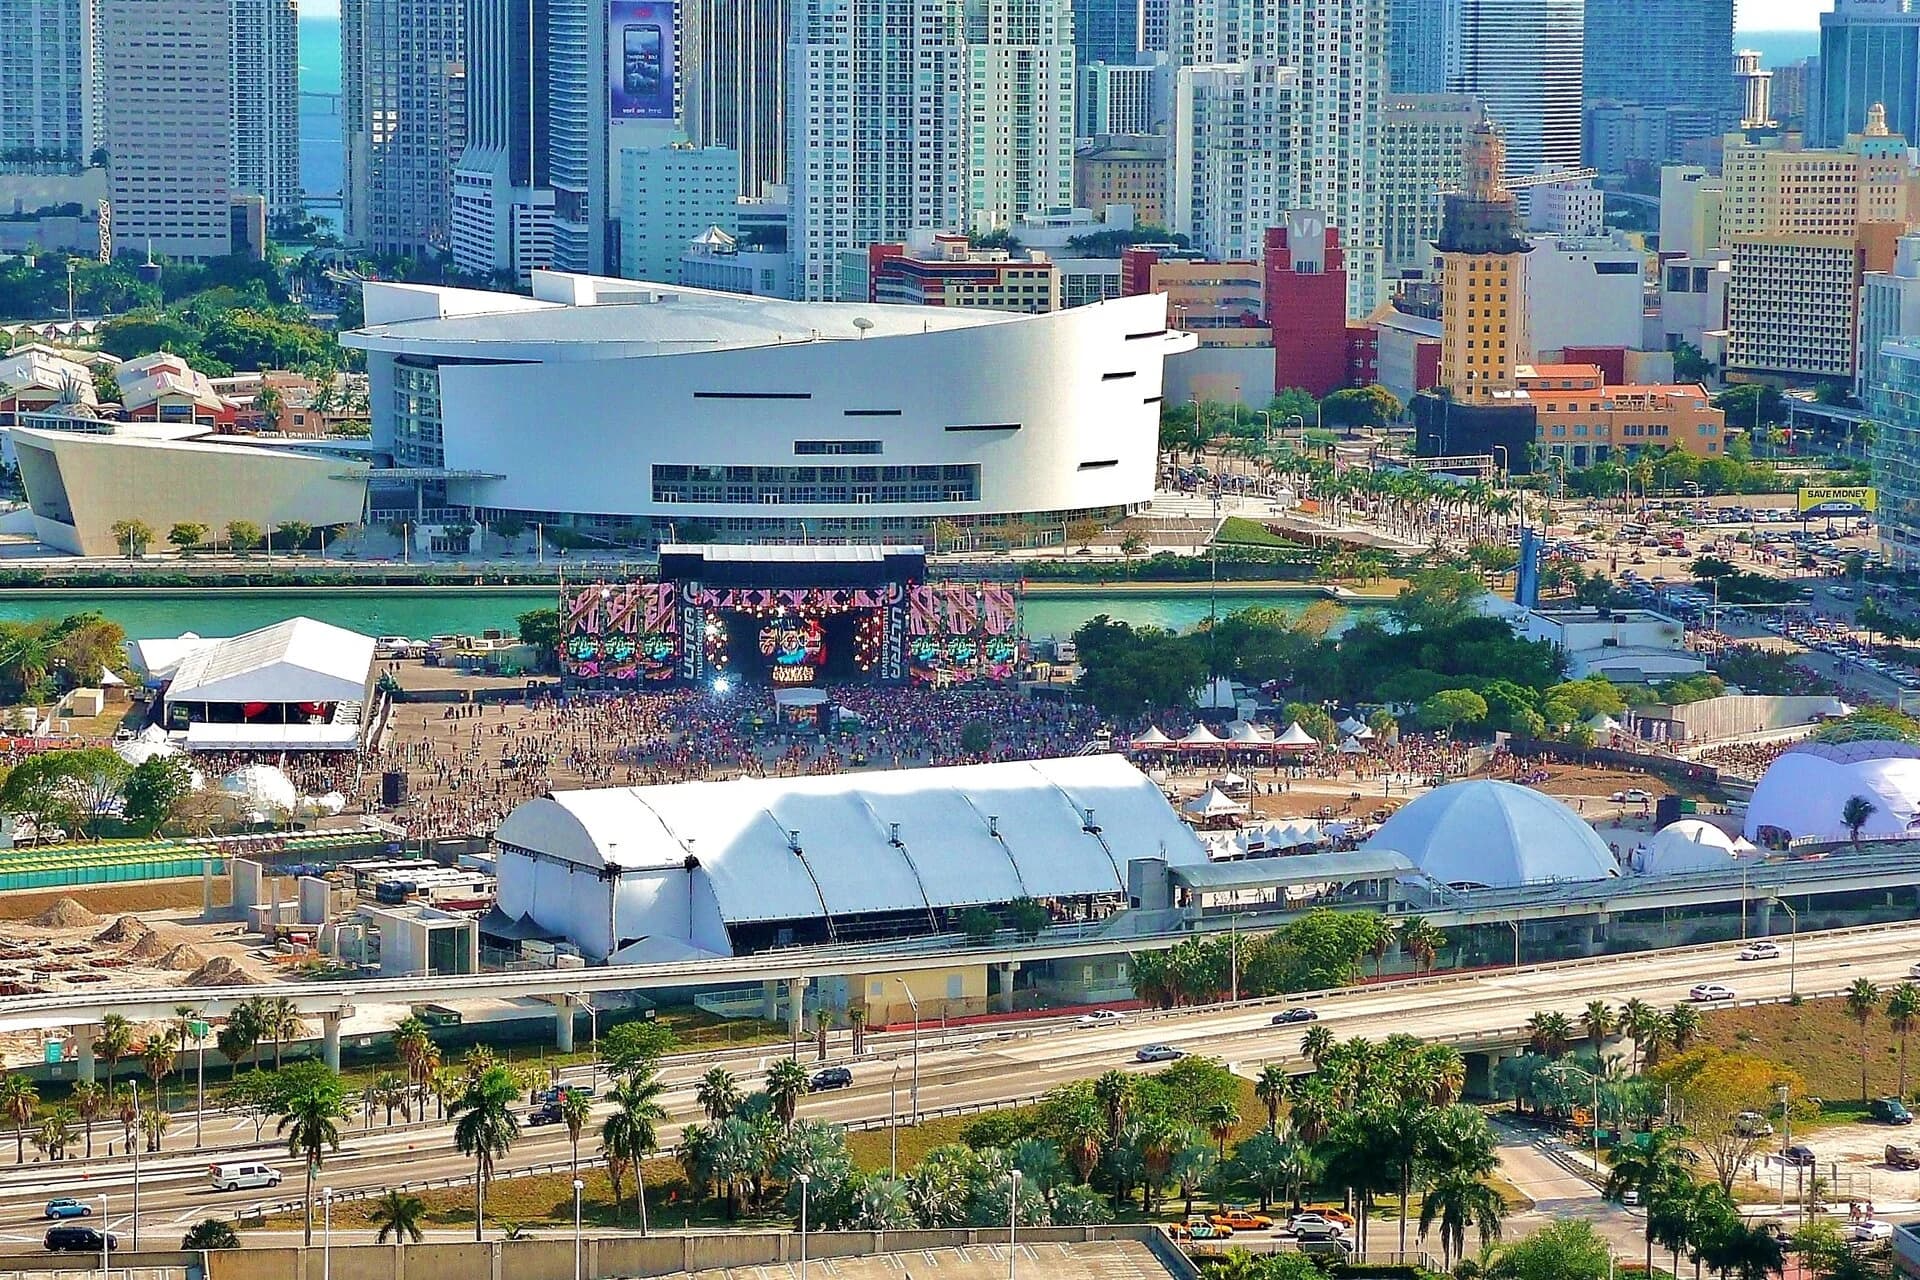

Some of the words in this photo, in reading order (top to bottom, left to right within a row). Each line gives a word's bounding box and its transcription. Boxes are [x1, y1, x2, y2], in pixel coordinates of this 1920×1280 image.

[1807, 490, 1832, 498] SAVE
[1832, 489, 1868, 498] MONEY
[683, 607, 695, 680] ULTRA
[881, 606, 889, 679] musicfestival
[889, 606, 902, 680] ULTRA
